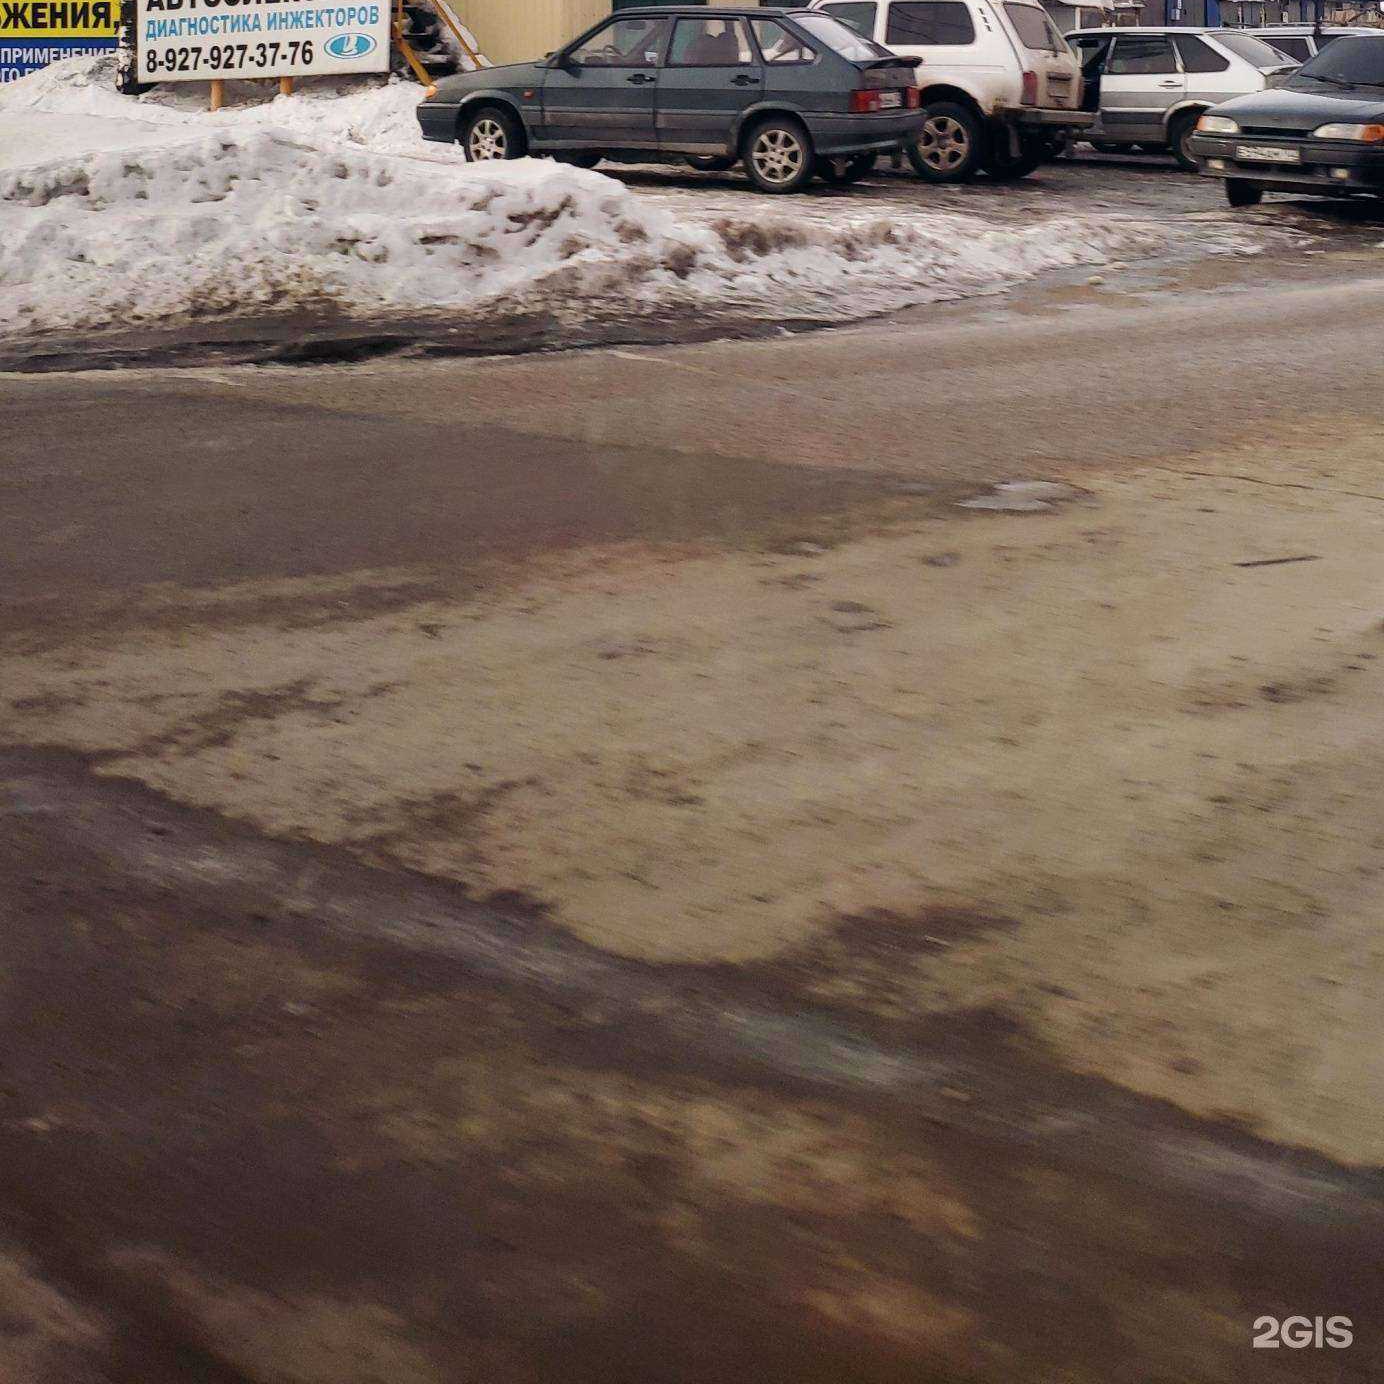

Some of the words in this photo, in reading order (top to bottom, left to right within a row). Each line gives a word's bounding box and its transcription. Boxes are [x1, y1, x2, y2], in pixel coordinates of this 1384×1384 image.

[145, 13, 262, 42] ДИАГНОСТИКА
[267, 5, 379, 31] ИНЖЕКТОРОВ
[146, 40, 313, 73] 8-927-927-37-76
